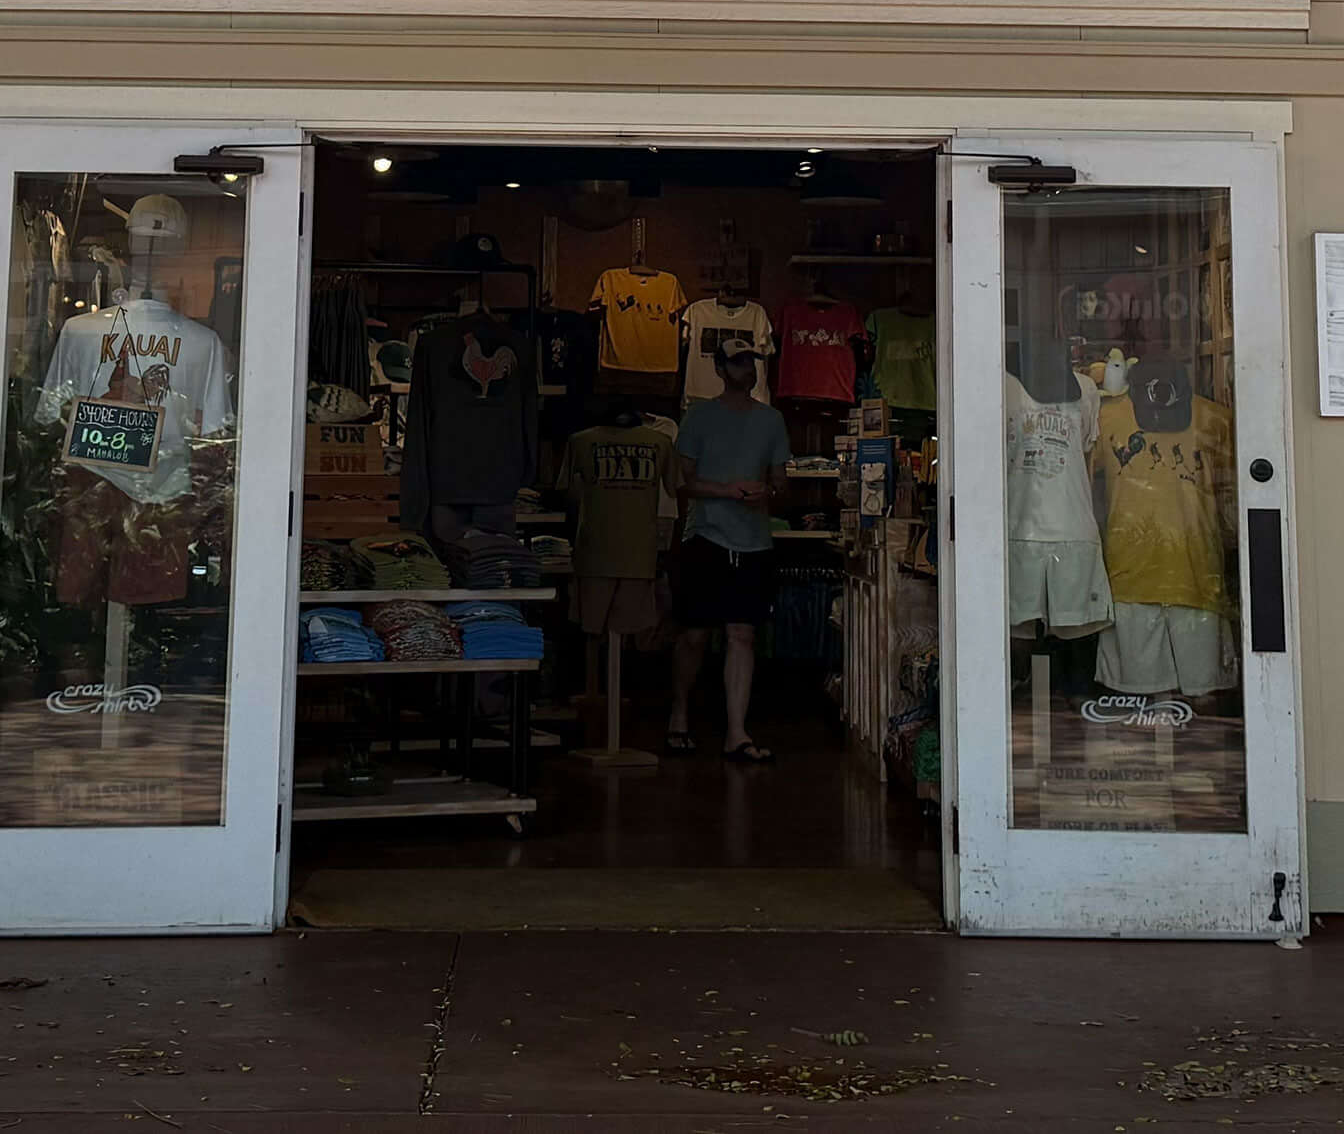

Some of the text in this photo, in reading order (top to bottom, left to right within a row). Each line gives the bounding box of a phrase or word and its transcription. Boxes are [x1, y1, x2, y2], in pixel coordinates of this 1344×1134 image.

[101, 333, 181, 366] KAUAI
[78, 404, 117, 424] STORE
[320, 426, 365, 443] FUN
[597, 458, 656, 480] DAD
[64, 684, 114, 698] crazy
[1098, 695, 1147, 713] crazy
[1085, 788, 1129, 809] FOR
